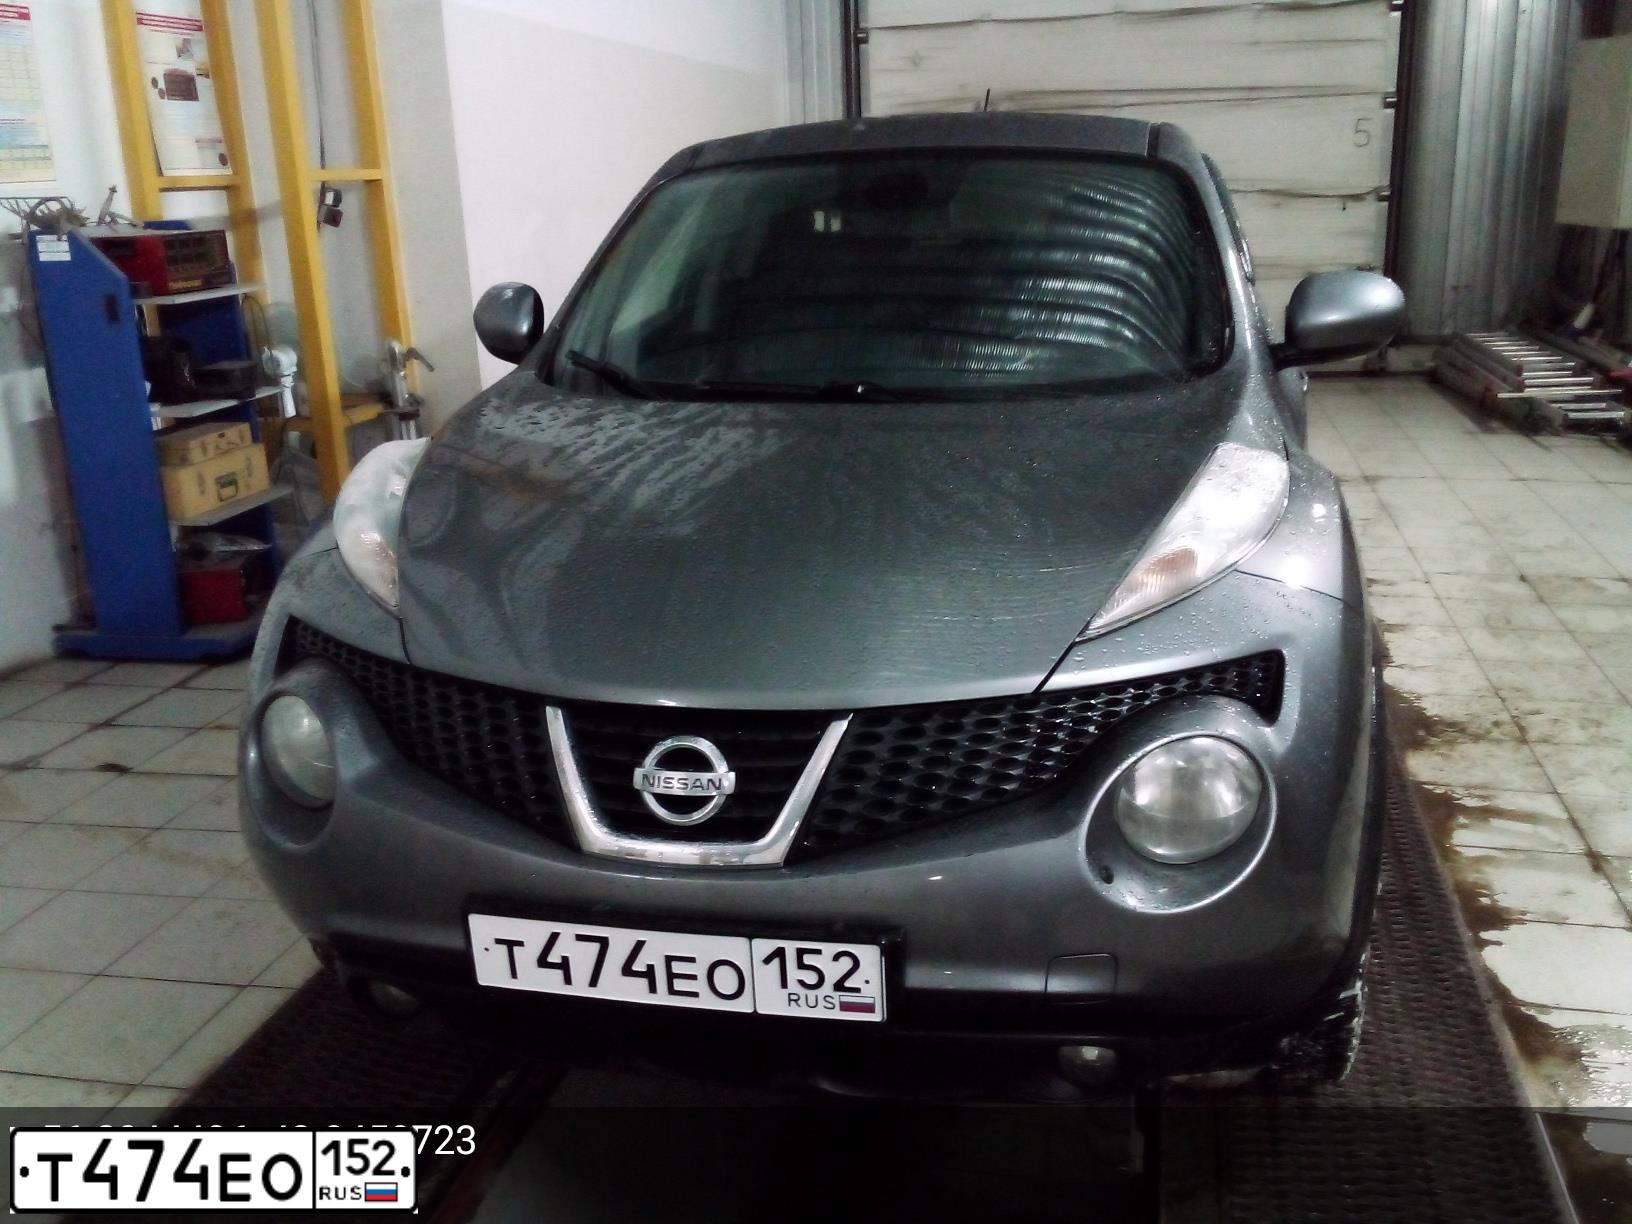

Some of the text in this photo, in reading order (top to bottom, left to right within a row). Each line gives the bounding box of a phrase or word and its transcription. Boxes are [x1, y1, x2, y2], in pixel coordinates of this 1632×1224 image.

[1353, 118, 1372, 147] 5
[641, 773, 722, 791] NISSAN
[762, 946, 862, 994] 152
[787, 992, 835, 1010] RUS
